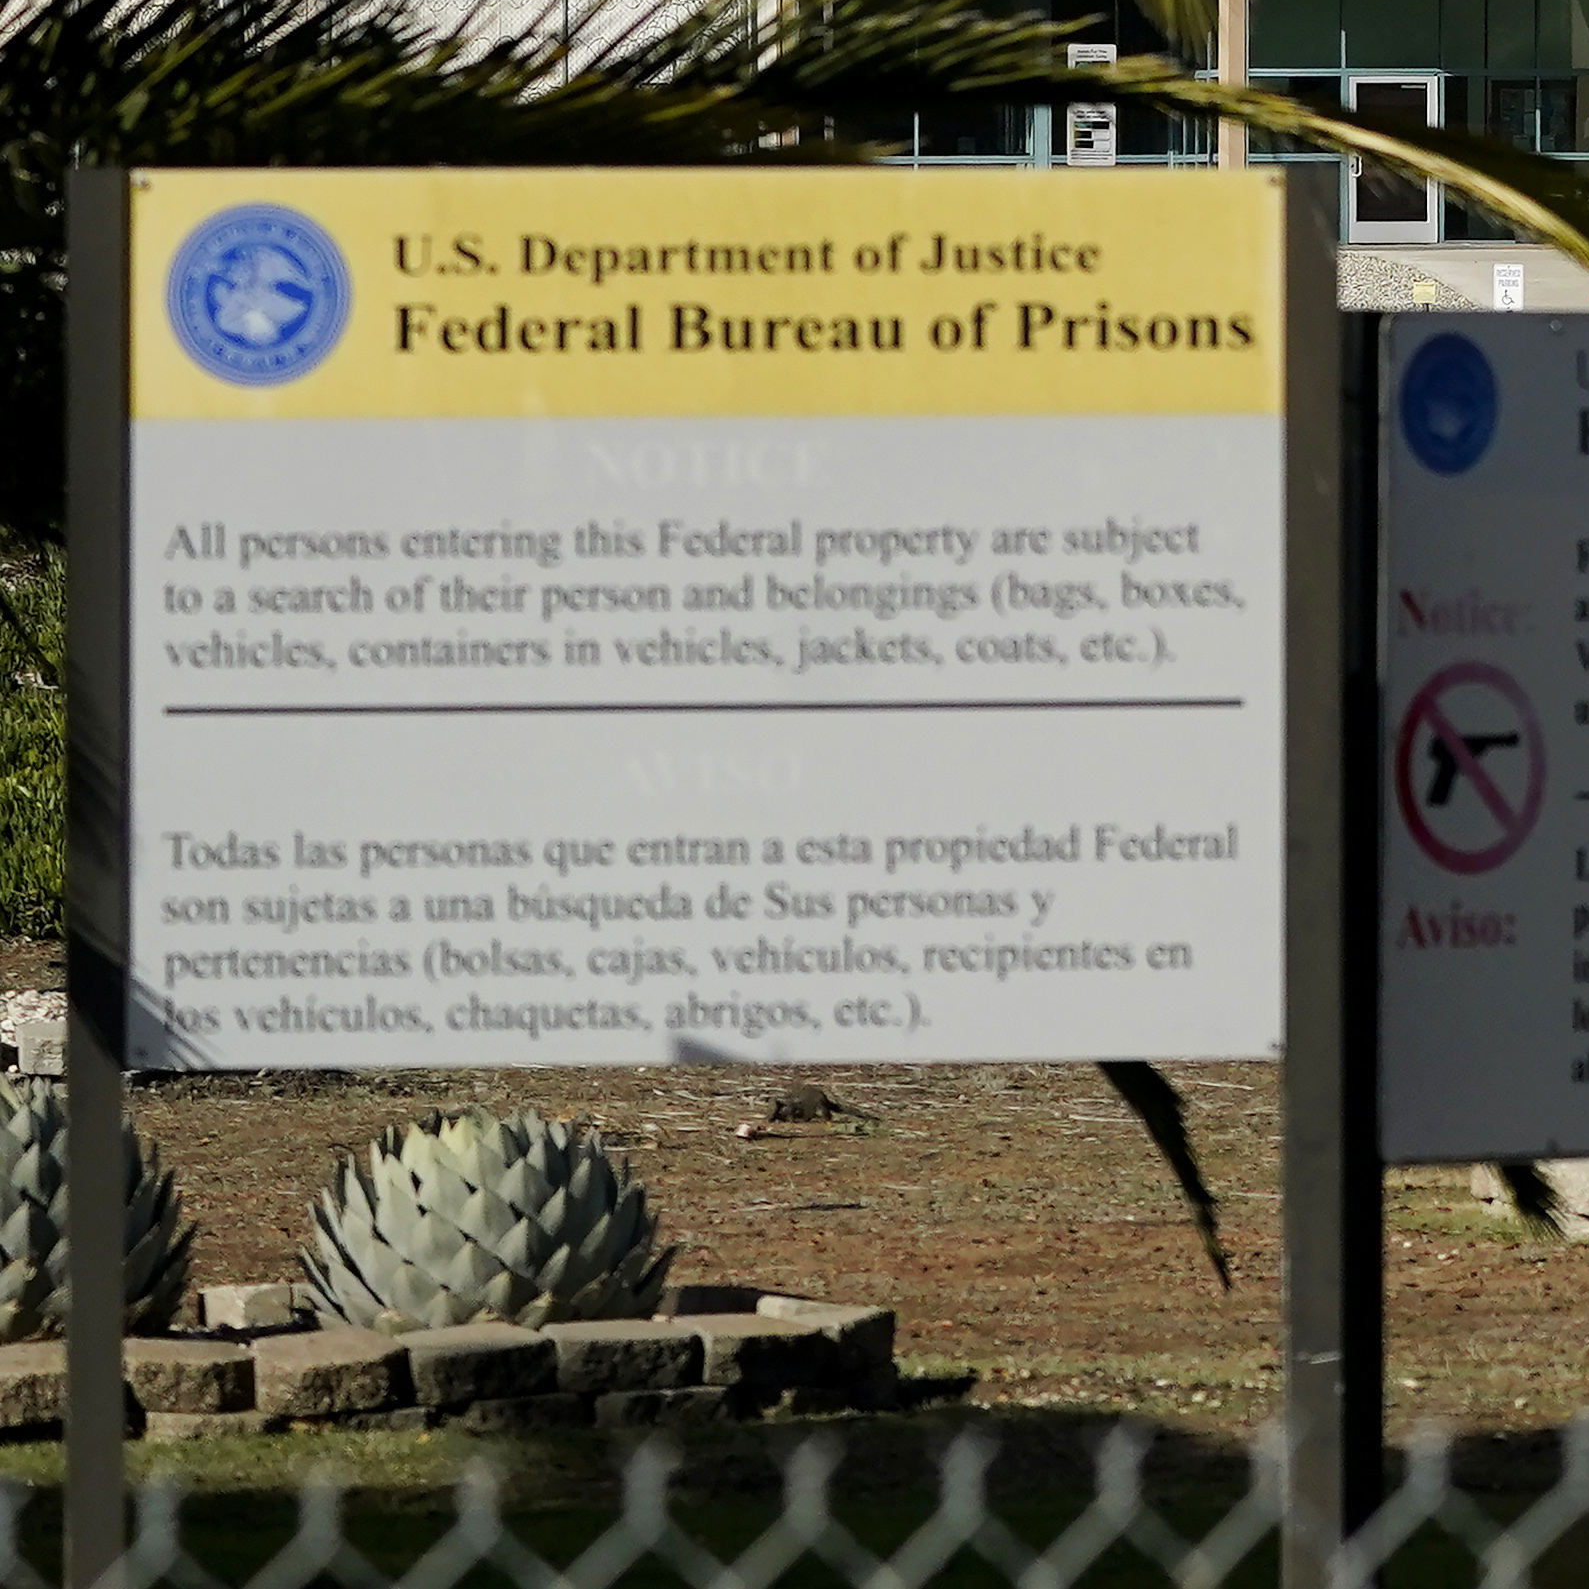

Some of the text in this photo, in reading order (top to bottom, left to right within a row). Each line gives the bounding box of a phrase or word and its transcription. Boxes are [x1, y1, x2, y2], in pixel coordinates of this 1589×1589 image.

[393, 230, 1101, 287] U.S. Department of Justice
[395, 298, 1256, 355] Federal Bureau of Prisons
[164, 516, 1200, 572] All persons entering this Federal property are subject
[163, 569, 1246, 622] to a search of their person and belongings (bags, boxes,
[164, 624, 1177, 676] vehicles, containers in vehicles, jackets, coats, etc.).
[162, 822, 1240, 879] Todas las personas que entran a esta propiedad Federal
[162, 890, 230, 925] son
[242, 882, 378, 935] sujetas
[389, 891, 412, 923] a
[423, 890, 495, 923] una
[704, 881, 752, 921] de
[763, 880, 834, 921] Sus
[846, 886, 1018, 929] personas
[1029, 886, 1056, 927] y
[1396, 901, 1518, 950] Aviso:
[164, 936, 411, 989] pertenencias
[422, 935, 576, 985] (bolsas,
[586, 934, 698, 987] cajas,
[922, 930, 1136, 982] recipientes
[1145, 940, 1193, 971] en
[163, 992, 221, 1036] los
[444, 992, 653, 1041] chaquetas,
[665, 987, 821, 1040] abrigos,
[833, 990, 932, 1034] etc.).
